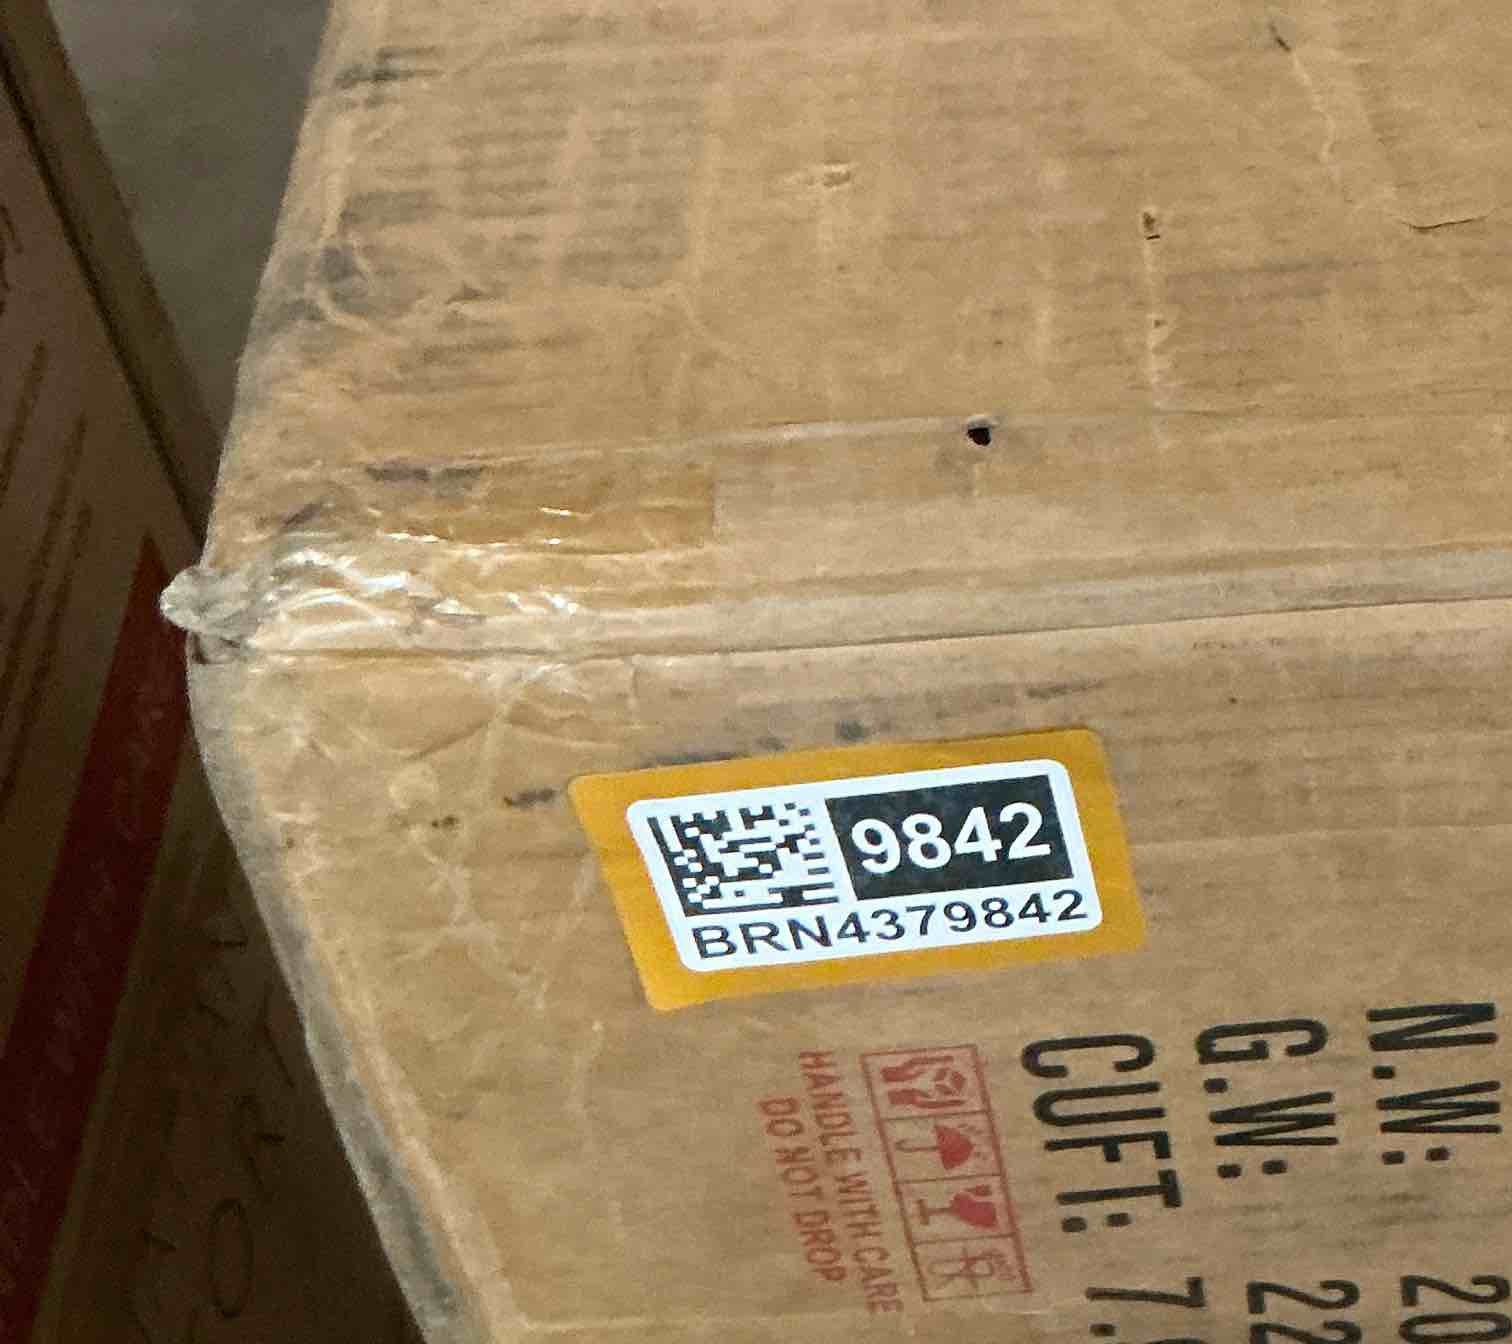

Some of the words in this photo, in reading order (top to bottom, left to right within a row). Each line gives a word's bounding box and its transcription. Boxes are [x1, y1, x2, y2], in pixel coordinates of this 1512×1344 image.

[850, 801, 1051, 875] 9842
[691, 888, 1089, 960] BRN4379842
[800, 1050, 861, 1167] HANDLE
[1022, 1034, 1183, 1233] CUFT:
[1195, 1018, 1340, 1181] G.W:
[1367, 1001, 1502, 1166] N.W:
[759, 1096, 801, 1138] DO
[795, 1211, 847, 1284] DROP
[838, 1170, 882, 1246] WITH
[852, 1248, 904, 1316] CARE
